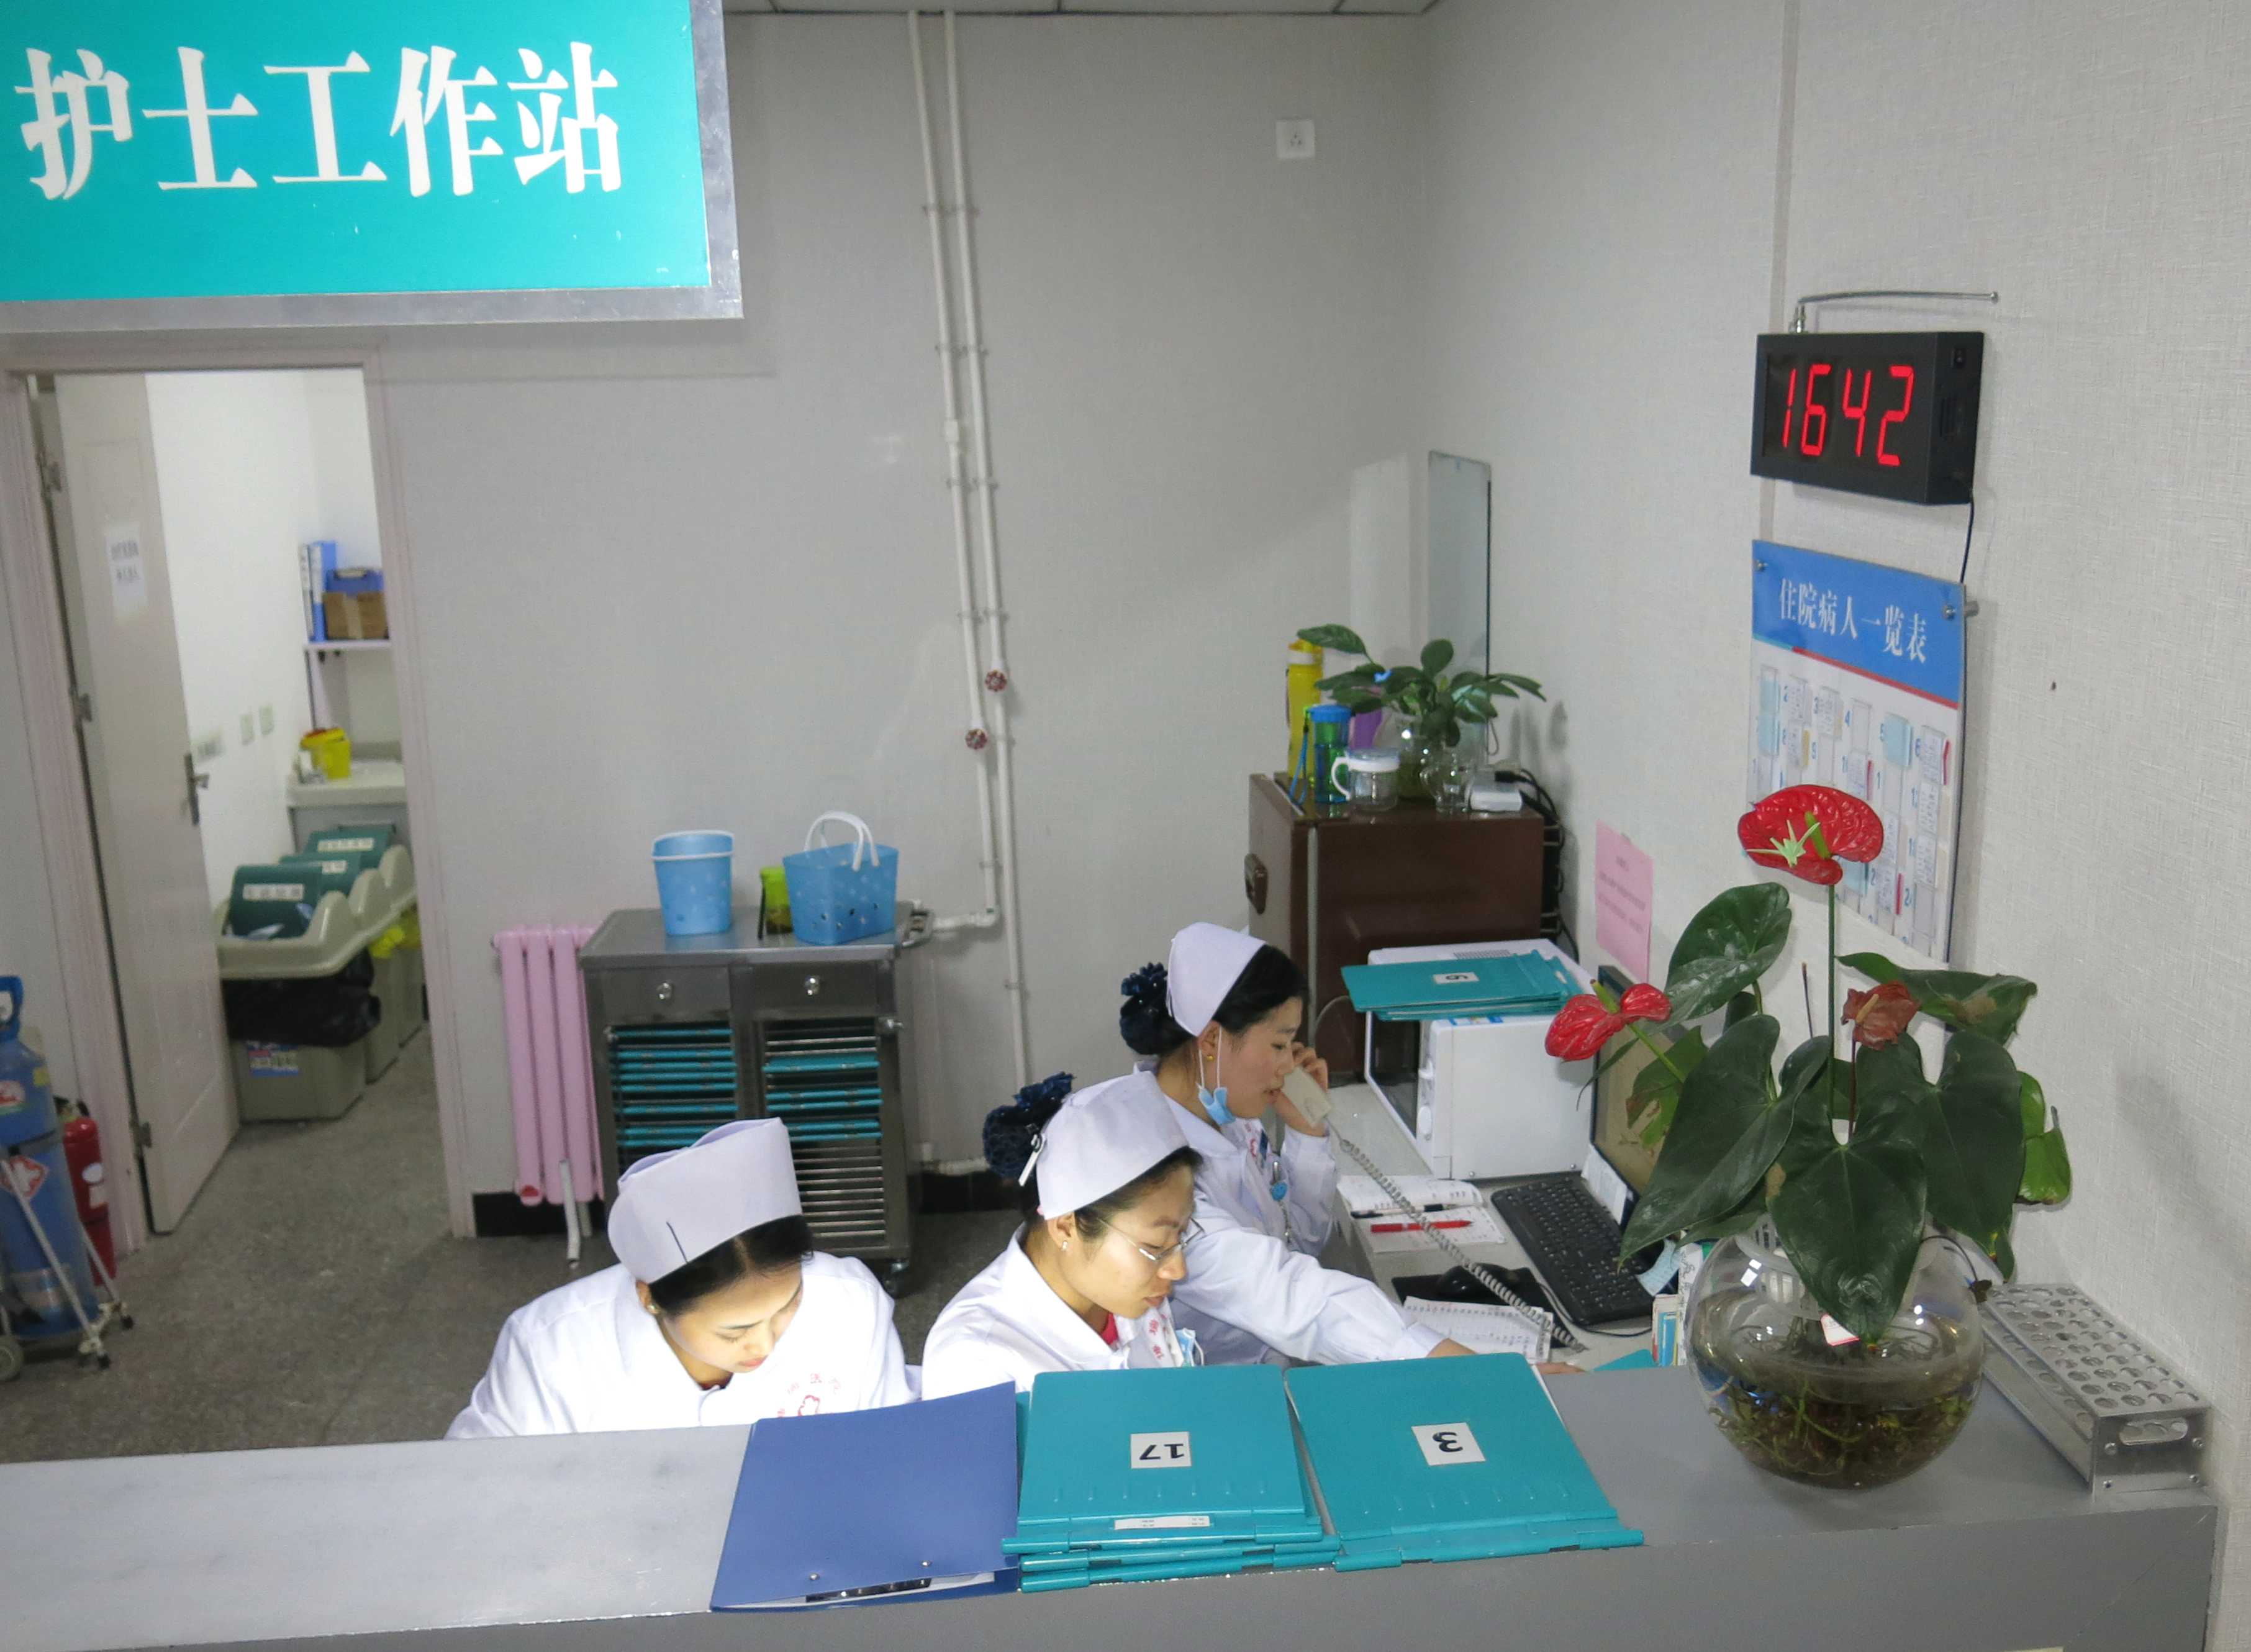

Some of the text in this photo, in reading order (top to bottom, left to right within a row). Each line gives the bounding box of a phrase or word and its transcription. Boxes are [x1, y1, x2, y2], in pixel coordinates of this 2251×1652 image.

[14, 41, 622, 199] 护士工作站
[1782, 364, 1914, 466] 1642
[1780, 578, 1927, 664] 住院病人一览表
[1139, 1443, 1185, 1460] 17
[1432, 1432, 1464, 1453] 3
